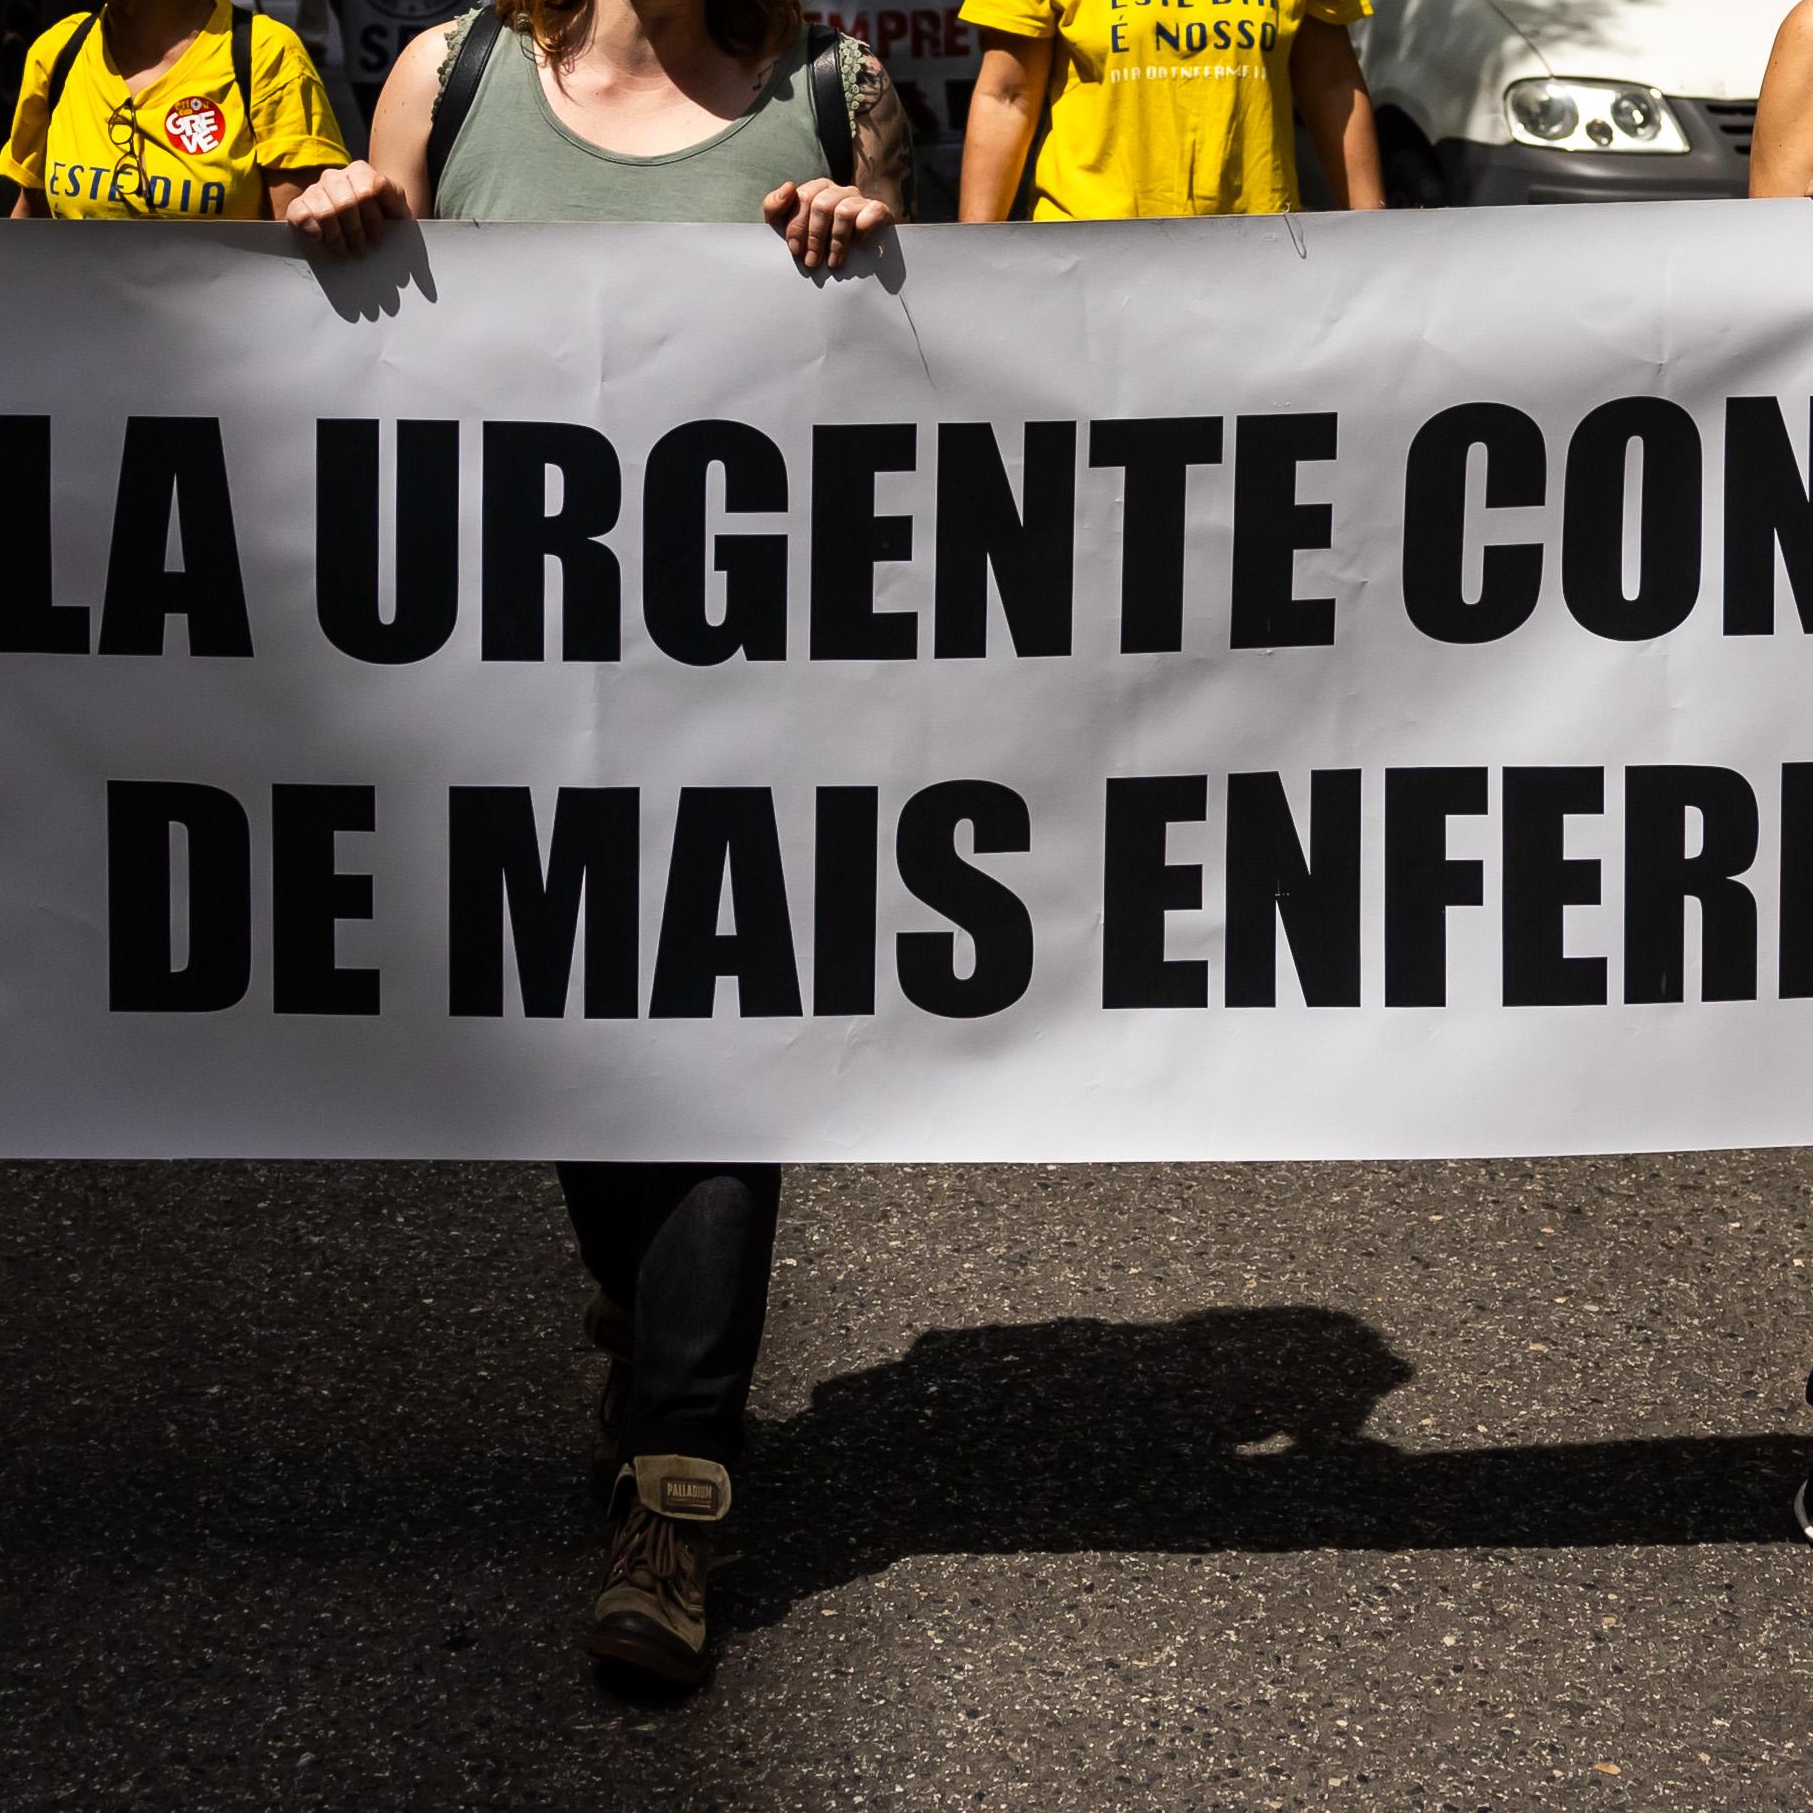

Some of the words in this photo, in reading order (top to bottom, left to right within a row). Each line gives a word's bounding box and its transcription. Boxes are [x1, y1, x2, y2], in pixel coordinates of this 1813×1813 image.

[1111, 15, 1130, 53] É
[1155, 19, 1277, 53] NOSSO
[166, 110, 218, 136] GRE
[49, 161, 134, 203] ESTE
[149, 174, 226, 215] DIA
[315, 413, 1338, 667] URGENTE
[106, 779, 381, 1016] DE
[448, 779, 1034, 1019] MAIS
